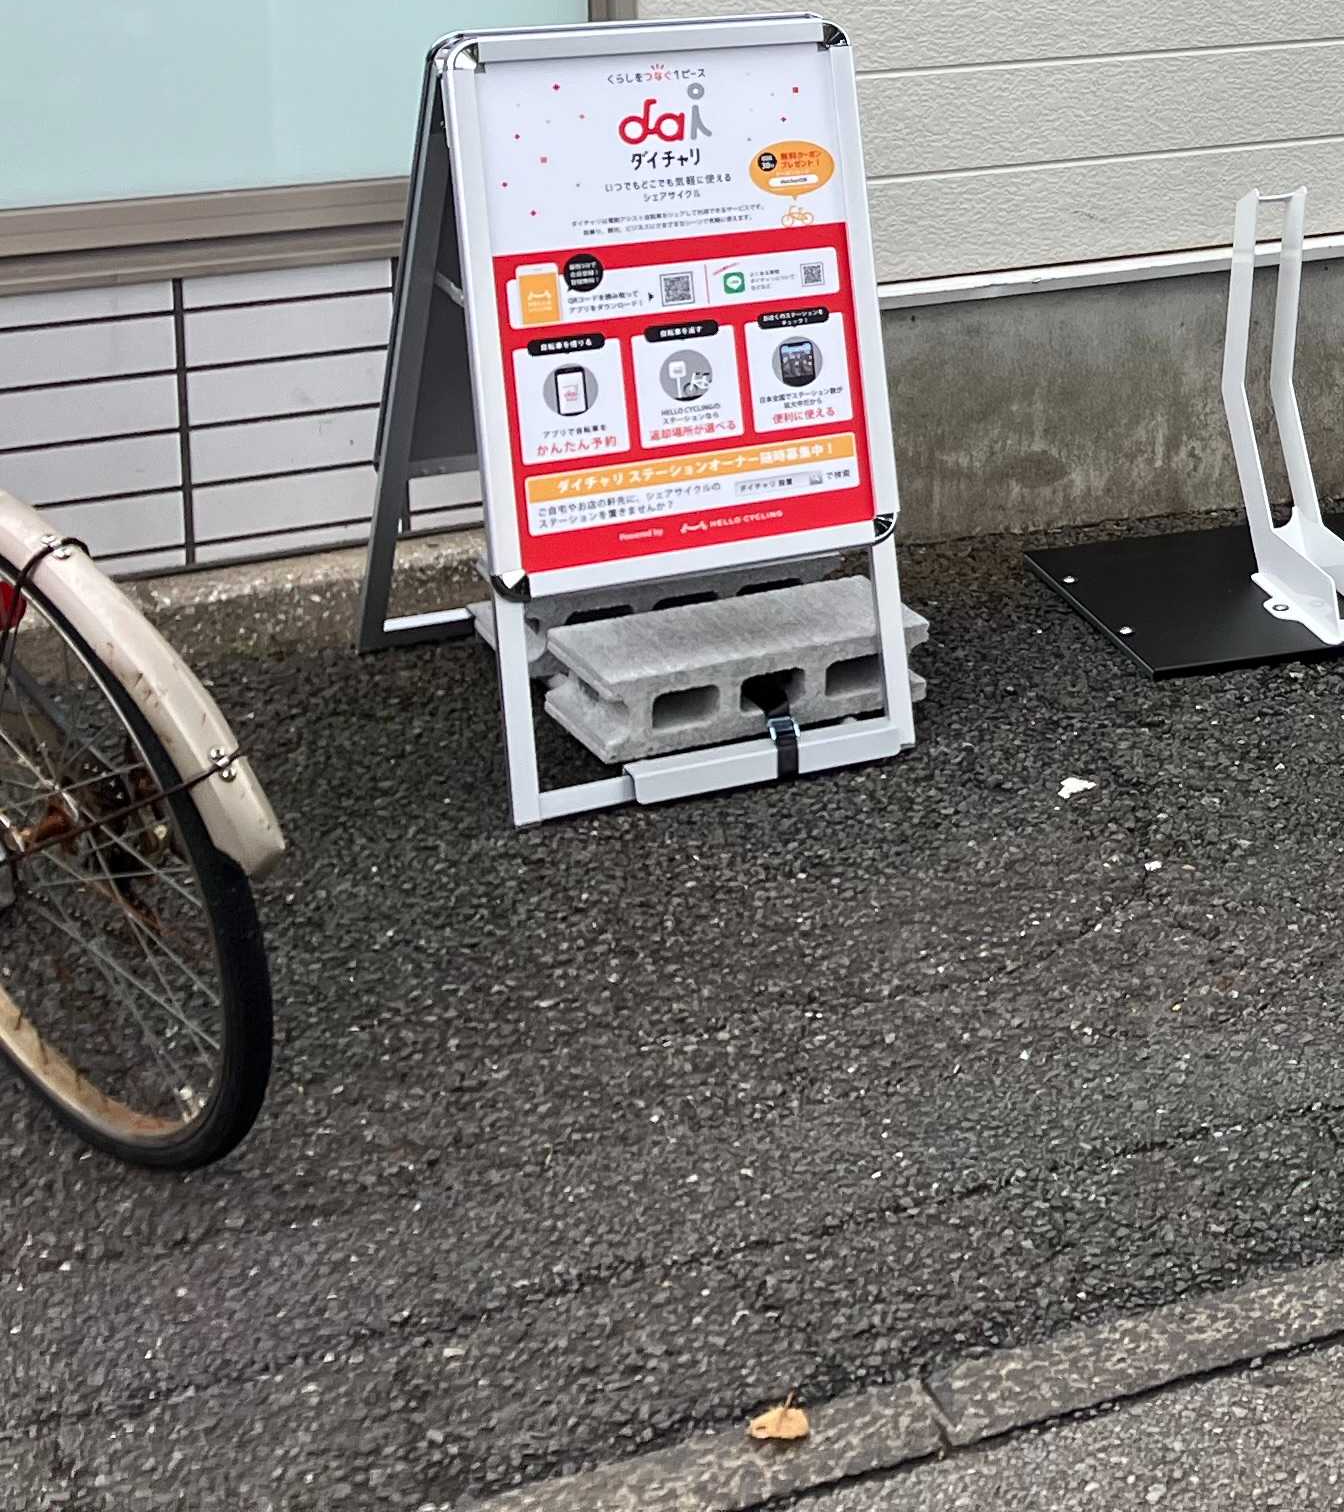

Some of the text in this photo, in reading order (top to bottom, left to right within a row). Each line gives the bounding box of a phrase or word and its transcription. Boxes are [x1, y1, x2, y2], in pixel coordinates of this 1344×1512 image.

[607, 68, 706, 85] くらしをつなぐ1ピース
[618, 83, 712, 144] dai
[631, 148, 701, 170] ダイチャリ
[604, 174, 732, 192] いつでもどこでも気軽に使える
[643, 189, 701, 202] シェアサイクル
[659, 326, 703, 338] 自転車を返す
[540, 338, 593, 352] 自転車を借りる
[760, 386, 843, 404] 日本全国でステーション数が
[663, 412, 719, 426] ステーションなら
[773, 407, 836, 425] 便利に使える
[543, 424, 607, 439] アプリで自転車を
[650, 420, 736, 441] 返却場所が選べる
[537, 436, 617, 457] かんたん予約
[557, 471, 625, 494] ダイチャリ
[825, 469, 851, 480] で検索
[539, 501, 674, 529] ステーションを置きませんか？
[709, 510, 784, 529] HELLO CYCLING
